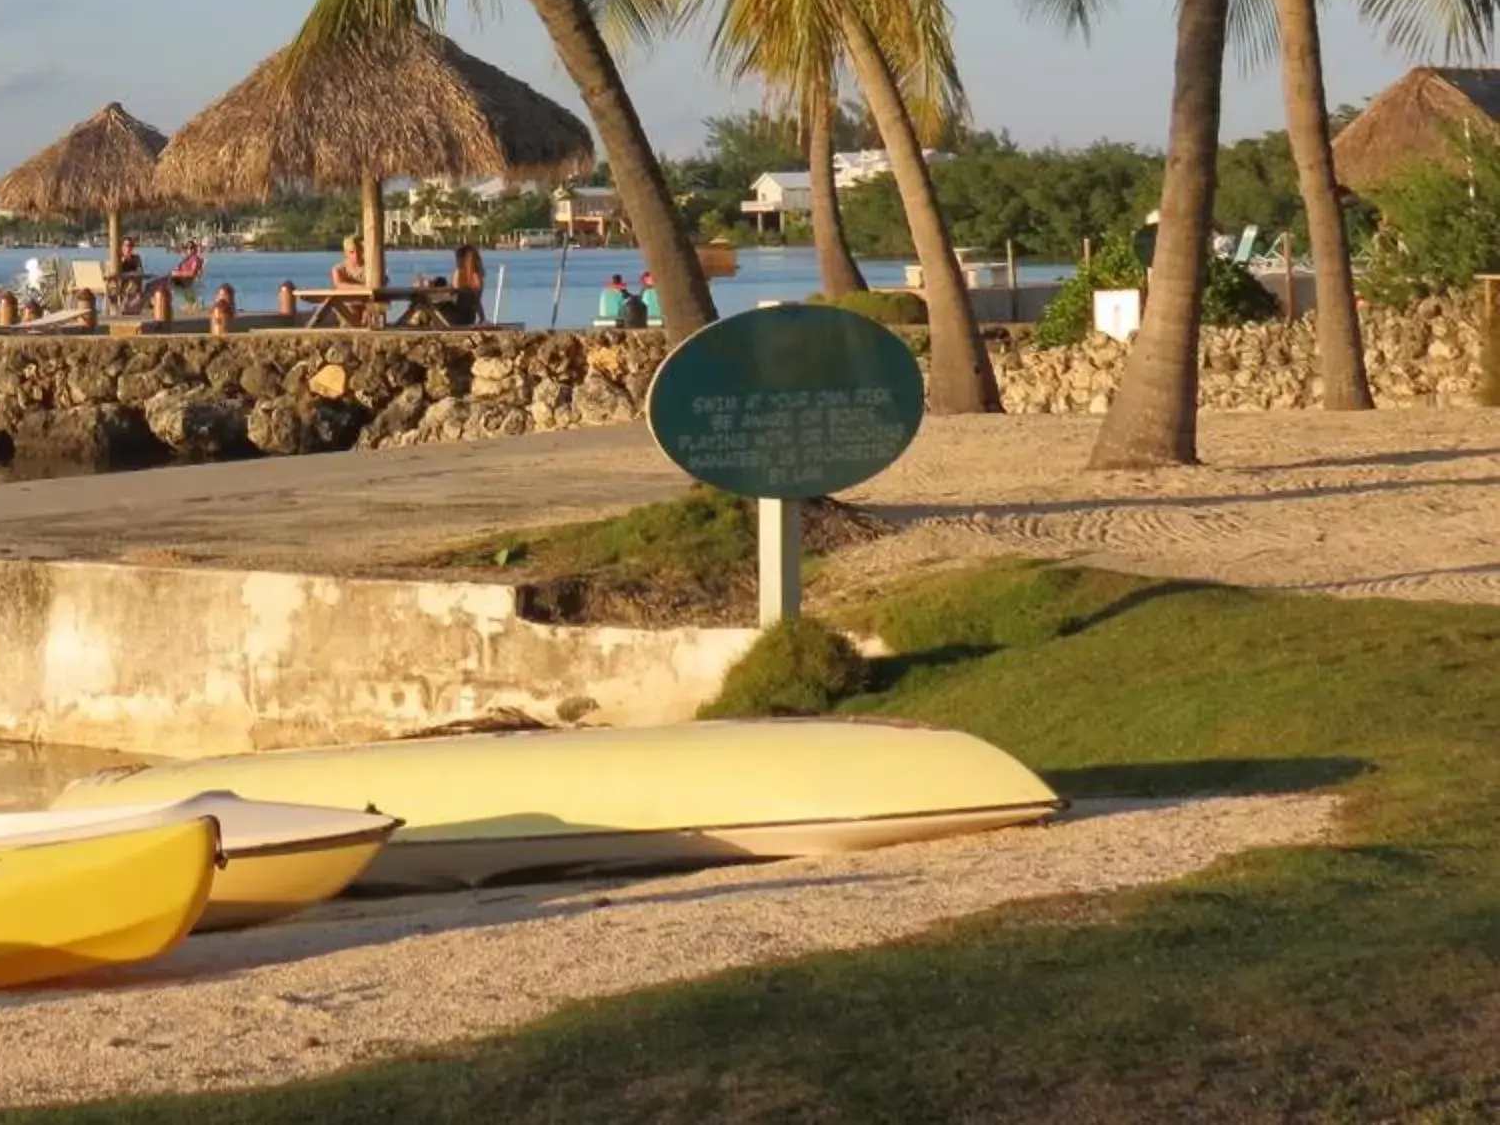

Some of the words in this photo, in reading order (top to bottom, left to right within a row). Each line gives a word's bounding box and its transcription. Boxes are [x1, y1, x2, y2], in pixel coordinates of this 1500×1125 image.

[692, 395, 738, 415] SWIM
[744, 393, 761, 409] AT
[768, 391, 809, 408] YOUR
[815, 389, 849, 407] OWN
[854, 387, 893, 405] RISK
